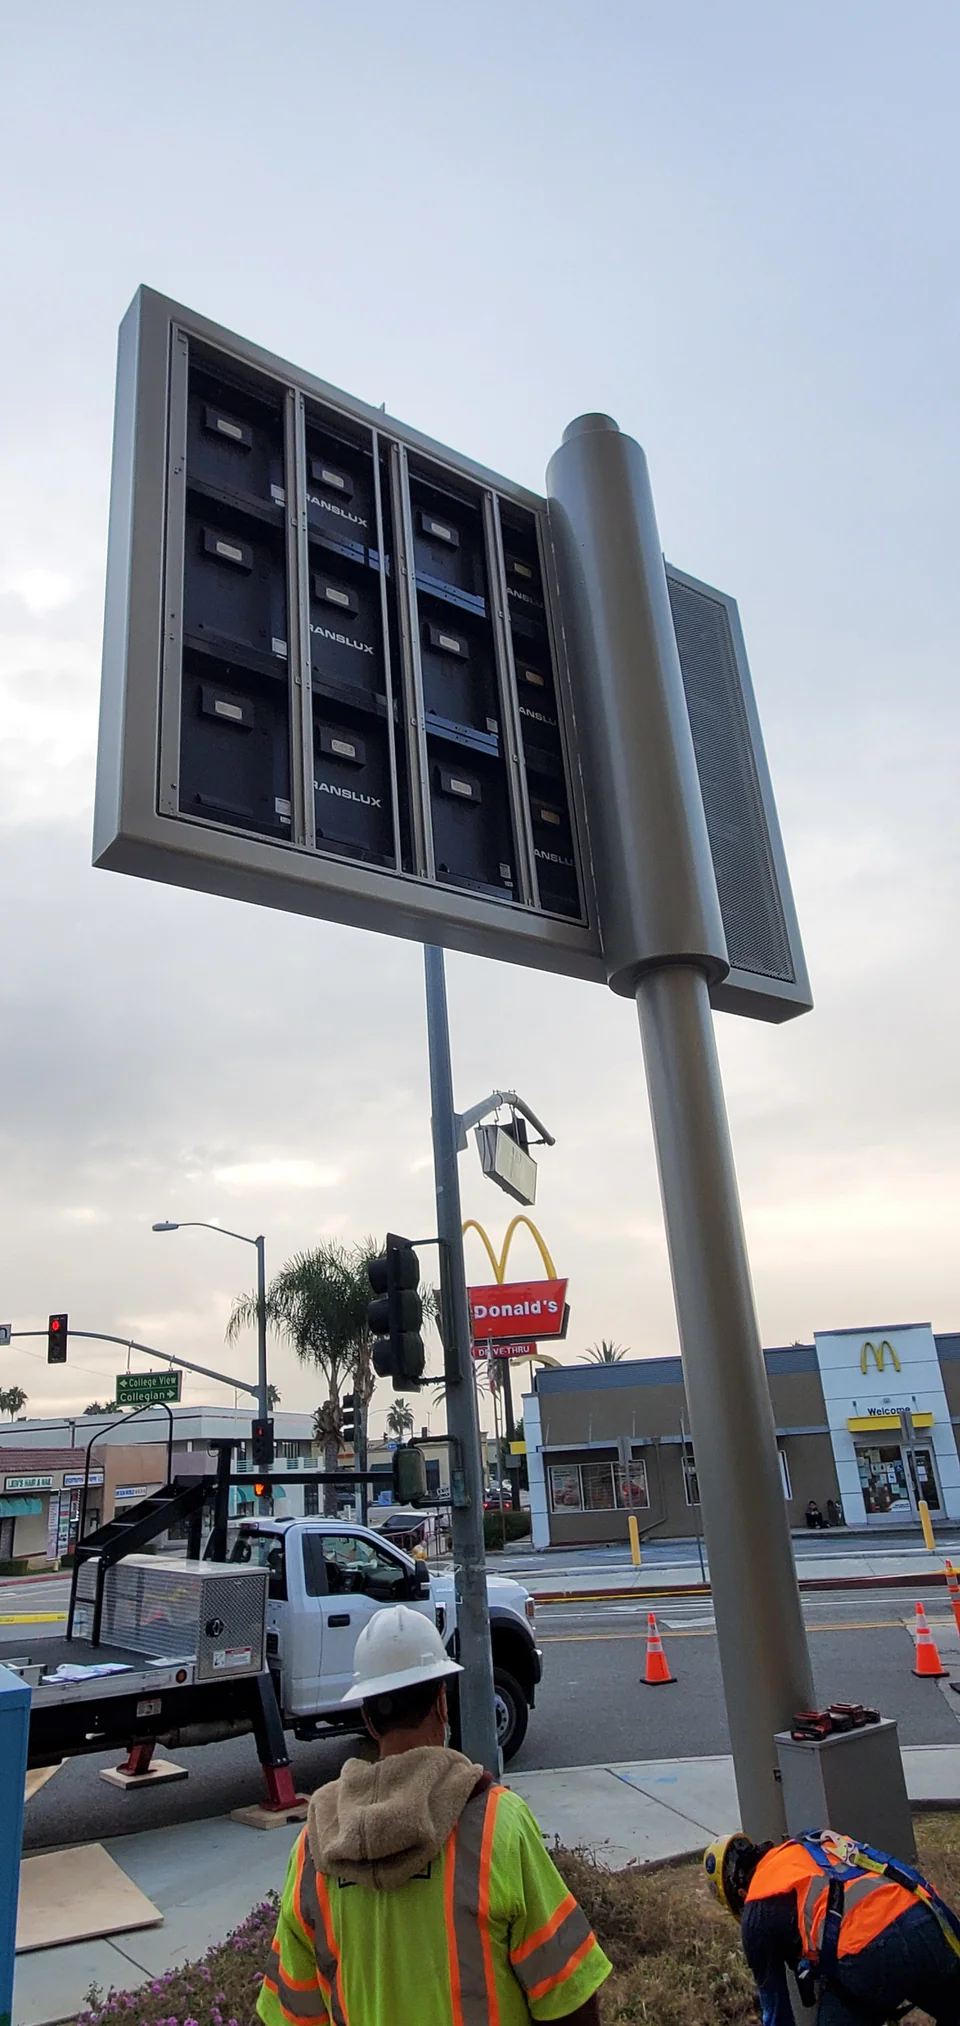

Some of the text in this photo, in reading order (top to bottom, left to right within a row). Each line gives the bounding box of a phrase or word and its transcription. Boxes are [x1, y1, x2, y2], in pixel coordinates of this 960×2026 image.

[478, 1345, 531, 1357] DVE-THRU
[128, 1375, 177, 1388] College View
[120, 1390, 166, 1402] Collegian
[867, 1406, 911, 1416] Welcome
